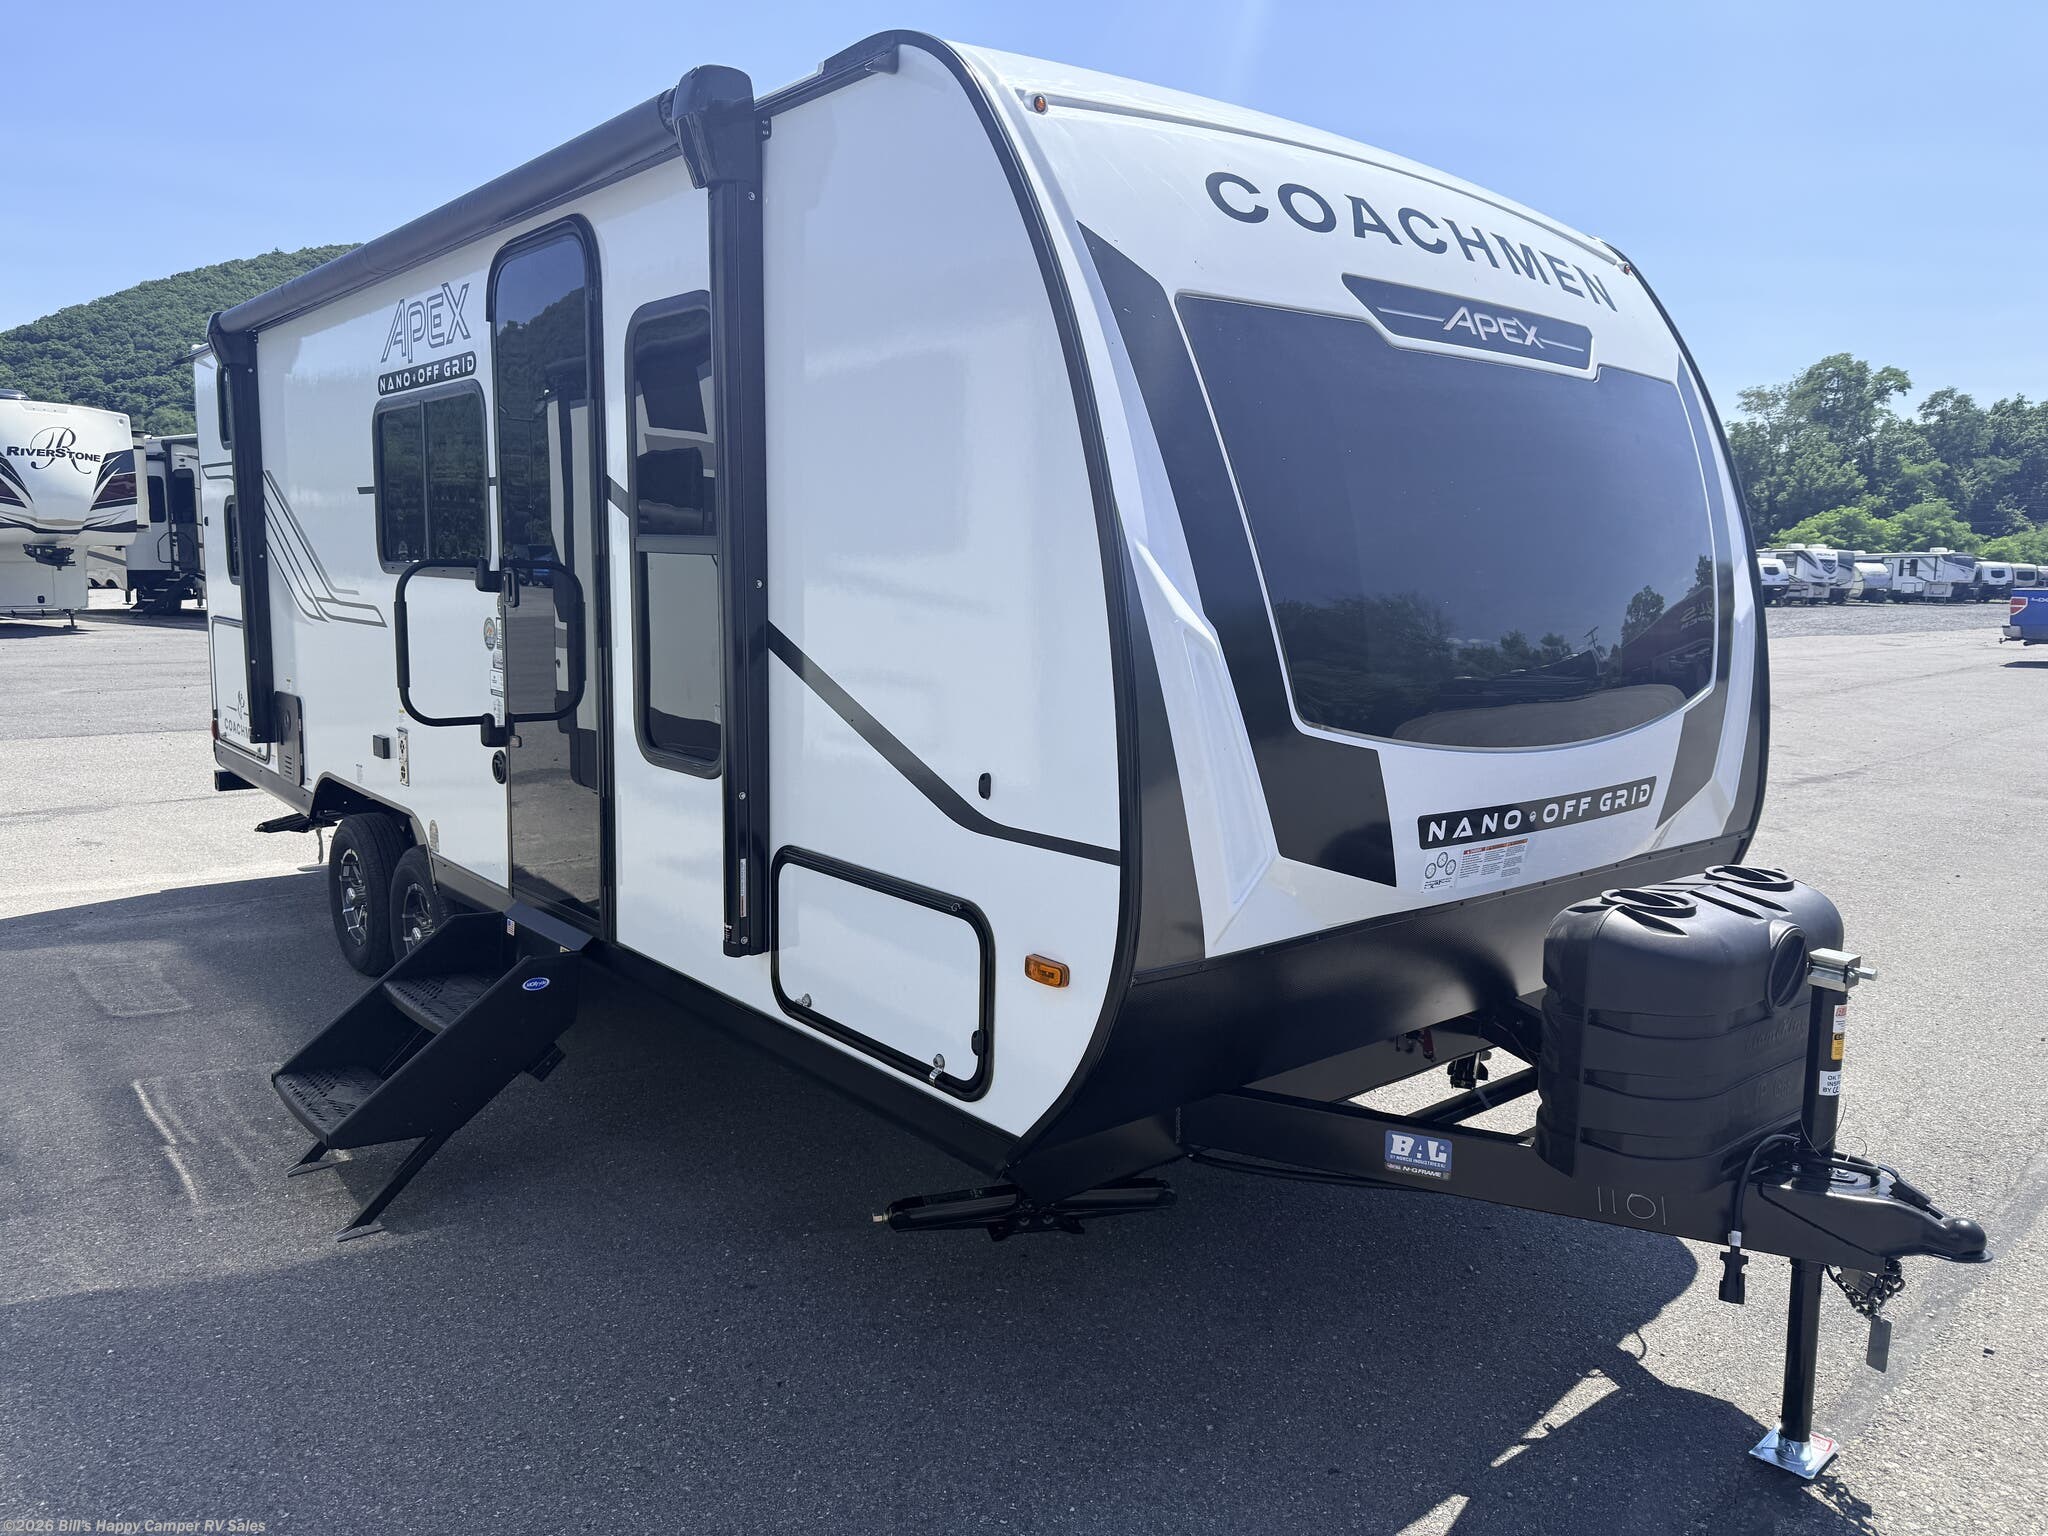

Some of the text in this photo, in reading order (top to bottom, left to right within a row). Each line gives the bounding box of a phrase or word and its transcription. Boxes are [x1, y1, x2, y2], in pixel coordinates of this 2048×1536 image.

[1205, 172, 1618, 313] COACHMEN
[381, 282, 472, 364] APEX
[1443, 306, 1545, 350] APEX
[380, 355, 474, 392] NANO OFF GRID
[224, 718, 251, 739] COACH
[1427, 783, 1651, 842] NANO OFF GRID
[1390, 1134, 1448, 1163] BAL
[1597, 1186, 1667, 1226] 1101
